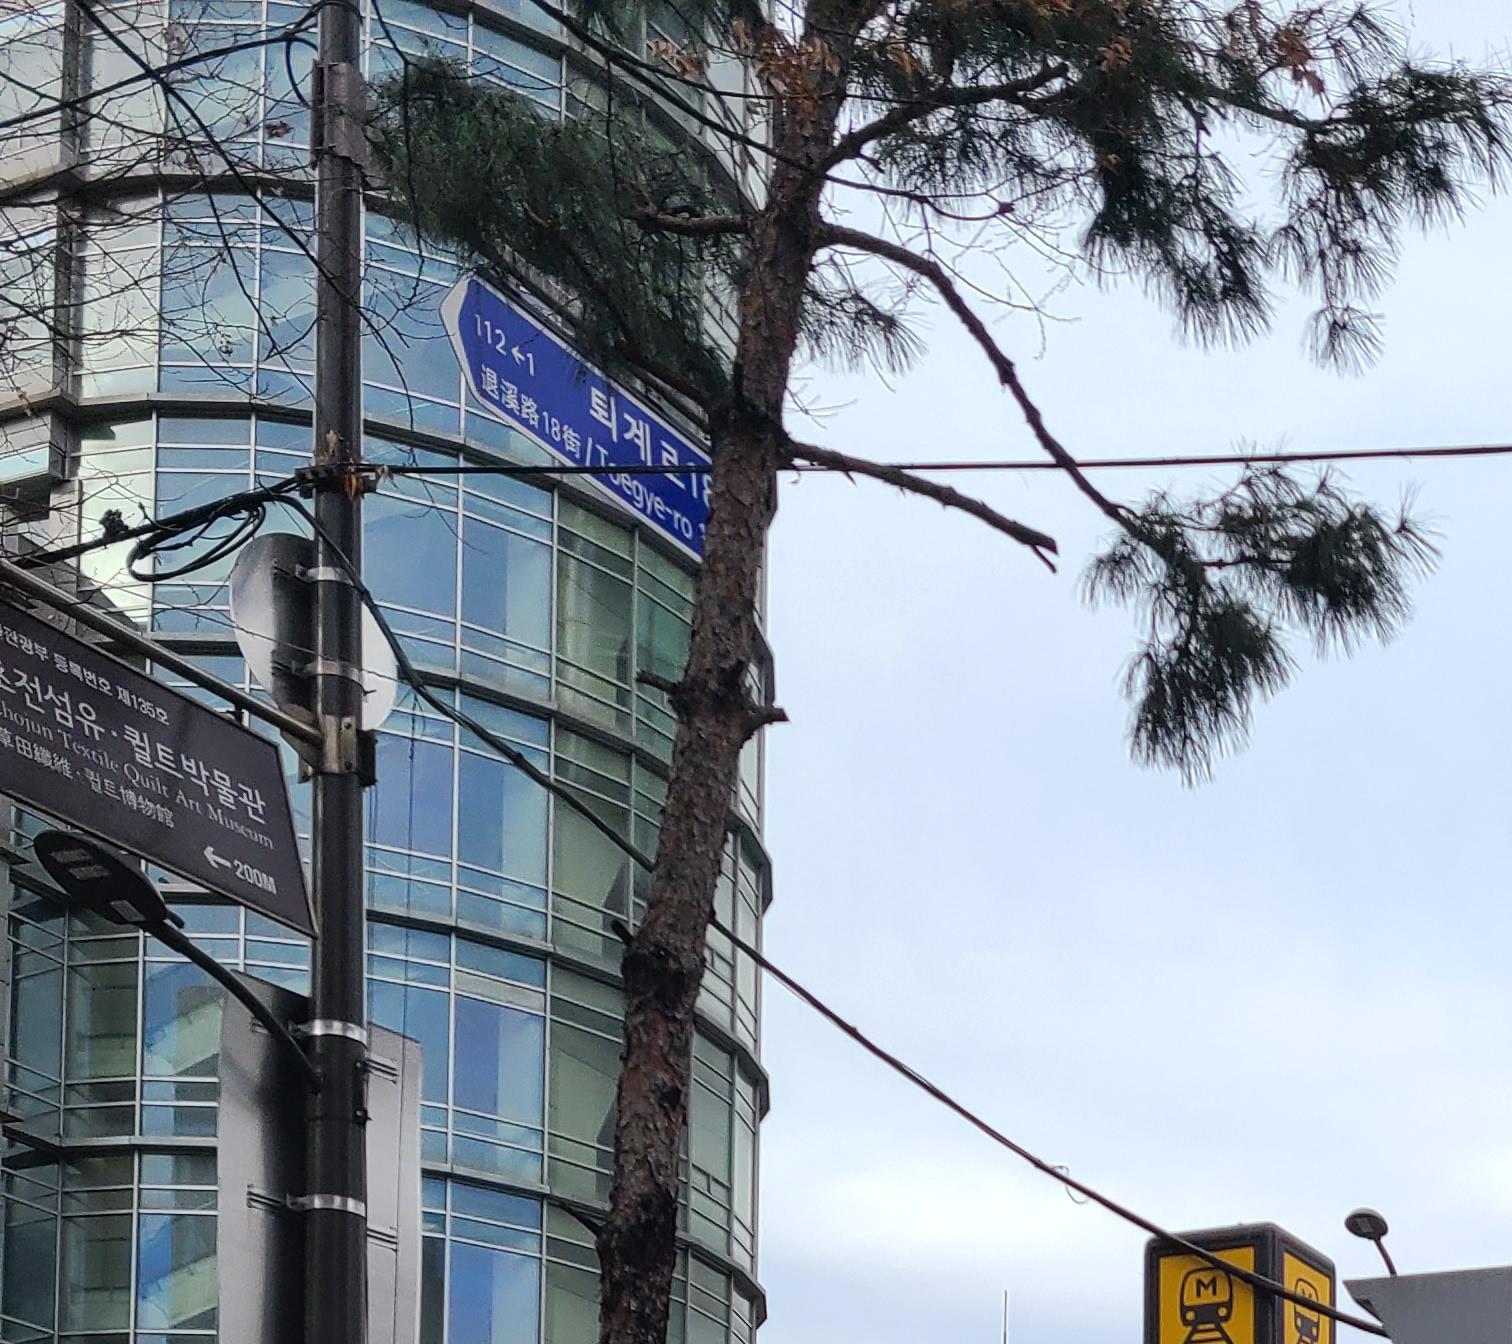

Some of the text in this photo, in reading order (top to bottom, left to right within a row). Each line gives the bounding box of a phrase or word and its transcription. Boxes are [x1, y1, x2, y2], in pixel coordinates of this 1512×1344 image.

[474, 315, 507, 356] 112
[53, 653, 114, 698] 등록번호
[175, 790, 203, 820] Art
[233, 860, 278, 896] 200M
